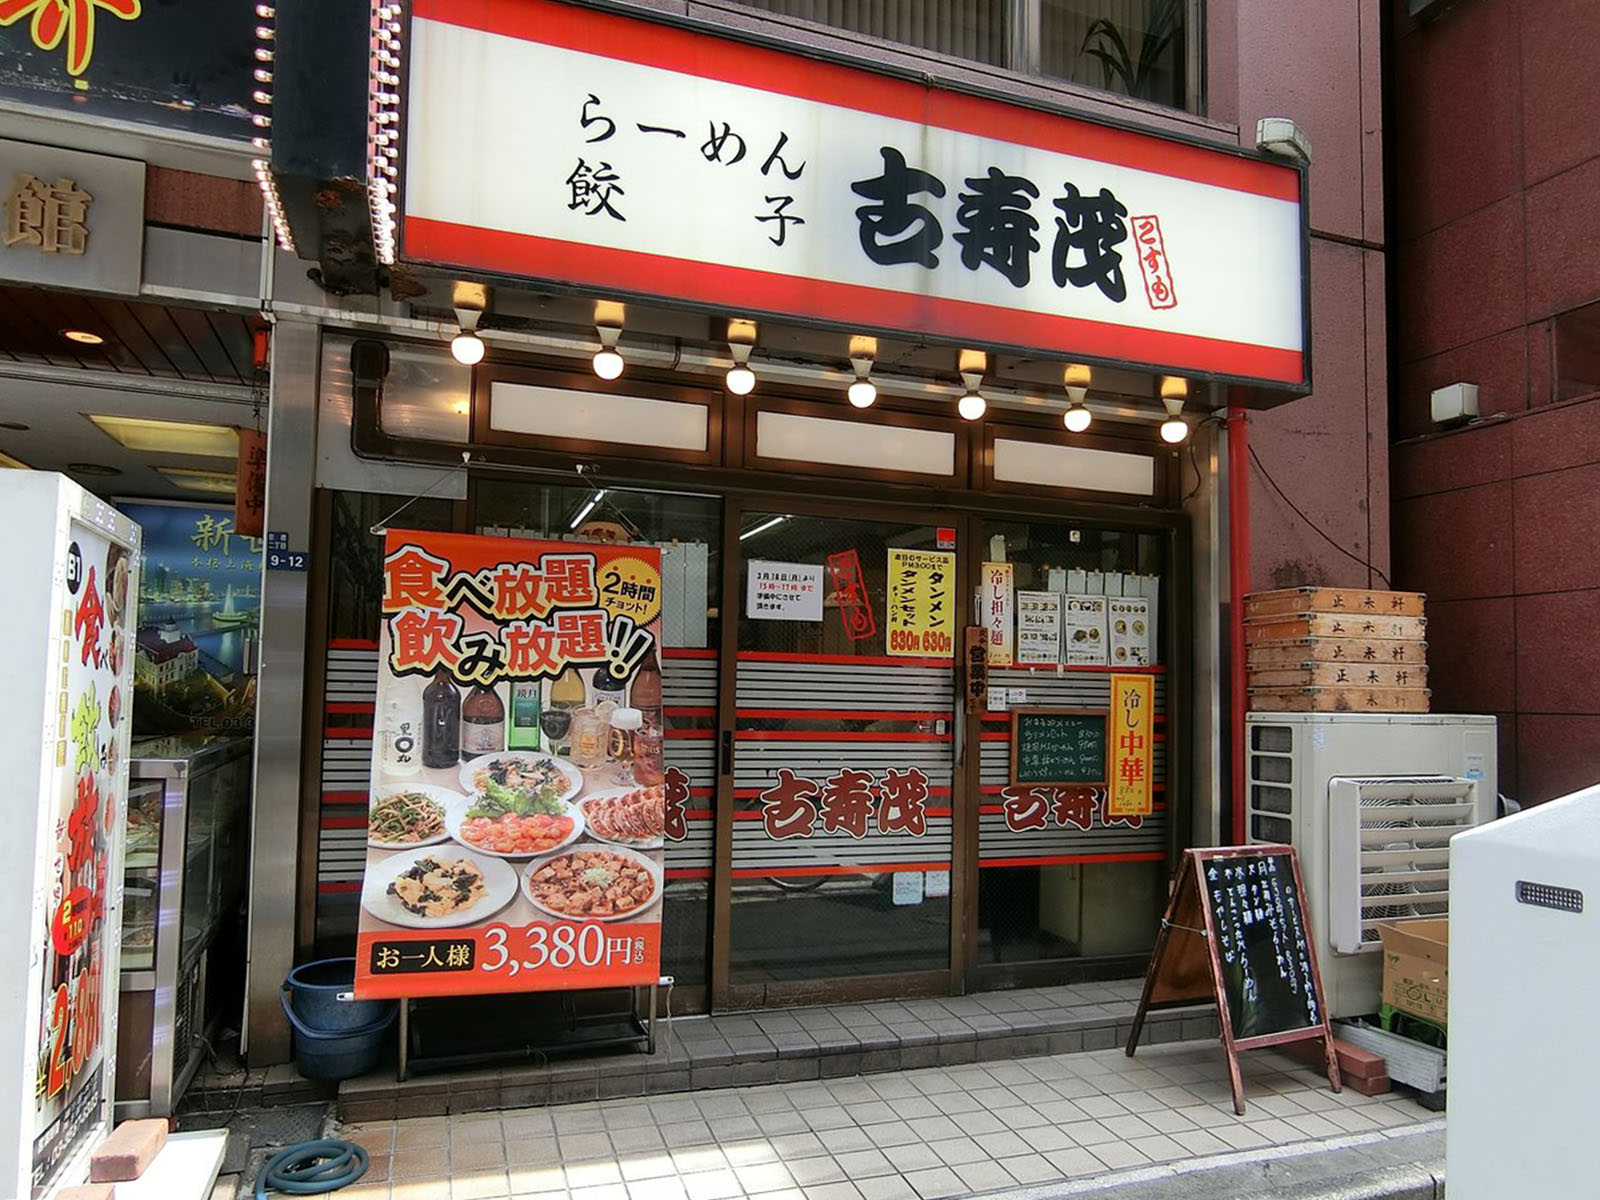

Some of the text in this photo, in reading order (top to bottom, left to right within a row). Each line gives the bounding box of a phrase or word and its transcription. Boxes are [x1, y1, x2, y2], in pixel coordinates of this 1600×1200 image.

[579, 93, 807, 180] らーめん
[3, 173, 94, 256] 館
[565, 157, 807, 247] 餃子
[851, 146, 1129, 303] 古寿茂
[1140, 220, 1171, 302] こすも
[67, 552, 81, 583] B1
[270, 554, 304, 568] 9-12
[383, 545, 597, 618] 食べ放題
[603, 571, 657, 604] 2時間
[604, 595, 648, 614] チョット!
[928, 571, 945, 628] タンメン
[1119, 688, 1144, 787] 冷し中華
[760, 766, 930, 841] 古寿茂
[375, 943, 471, 969] お一人様
[481, 924, 633, 977] 3,380円
